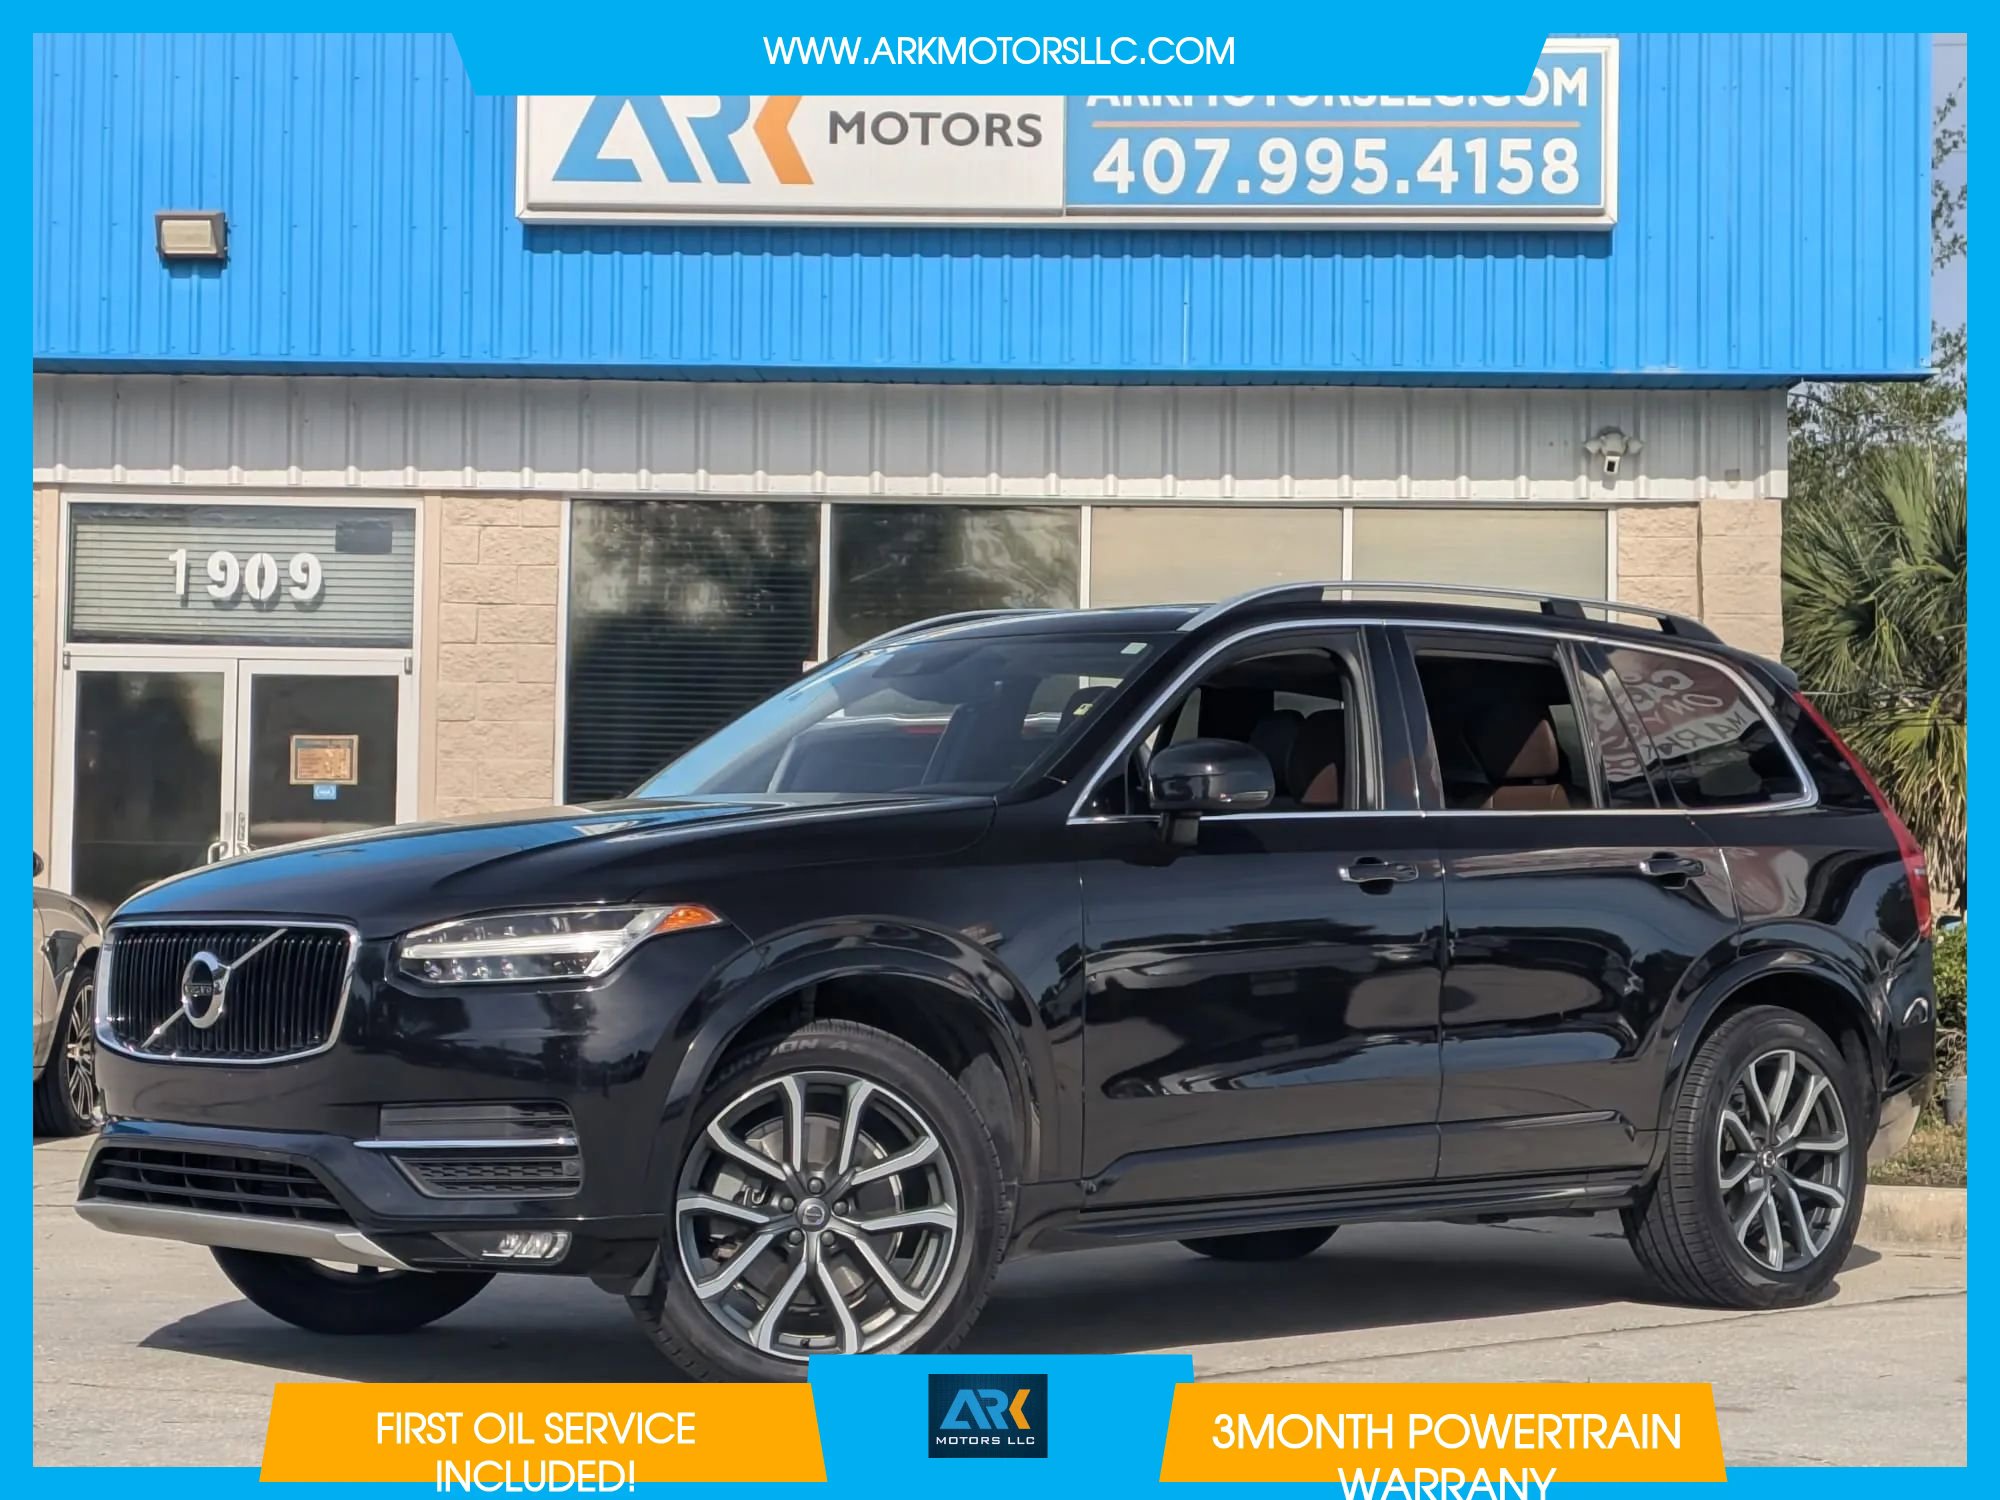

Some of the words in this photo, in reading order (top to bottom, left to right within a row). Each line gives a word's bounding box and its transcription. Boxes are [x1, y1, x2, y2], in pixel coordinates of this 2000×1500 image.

[828, 110, 1043, 149] MOTORS
[1092, 136, 1581, 196] 407.995.4158
[168, 548, 322, 600] 1909
